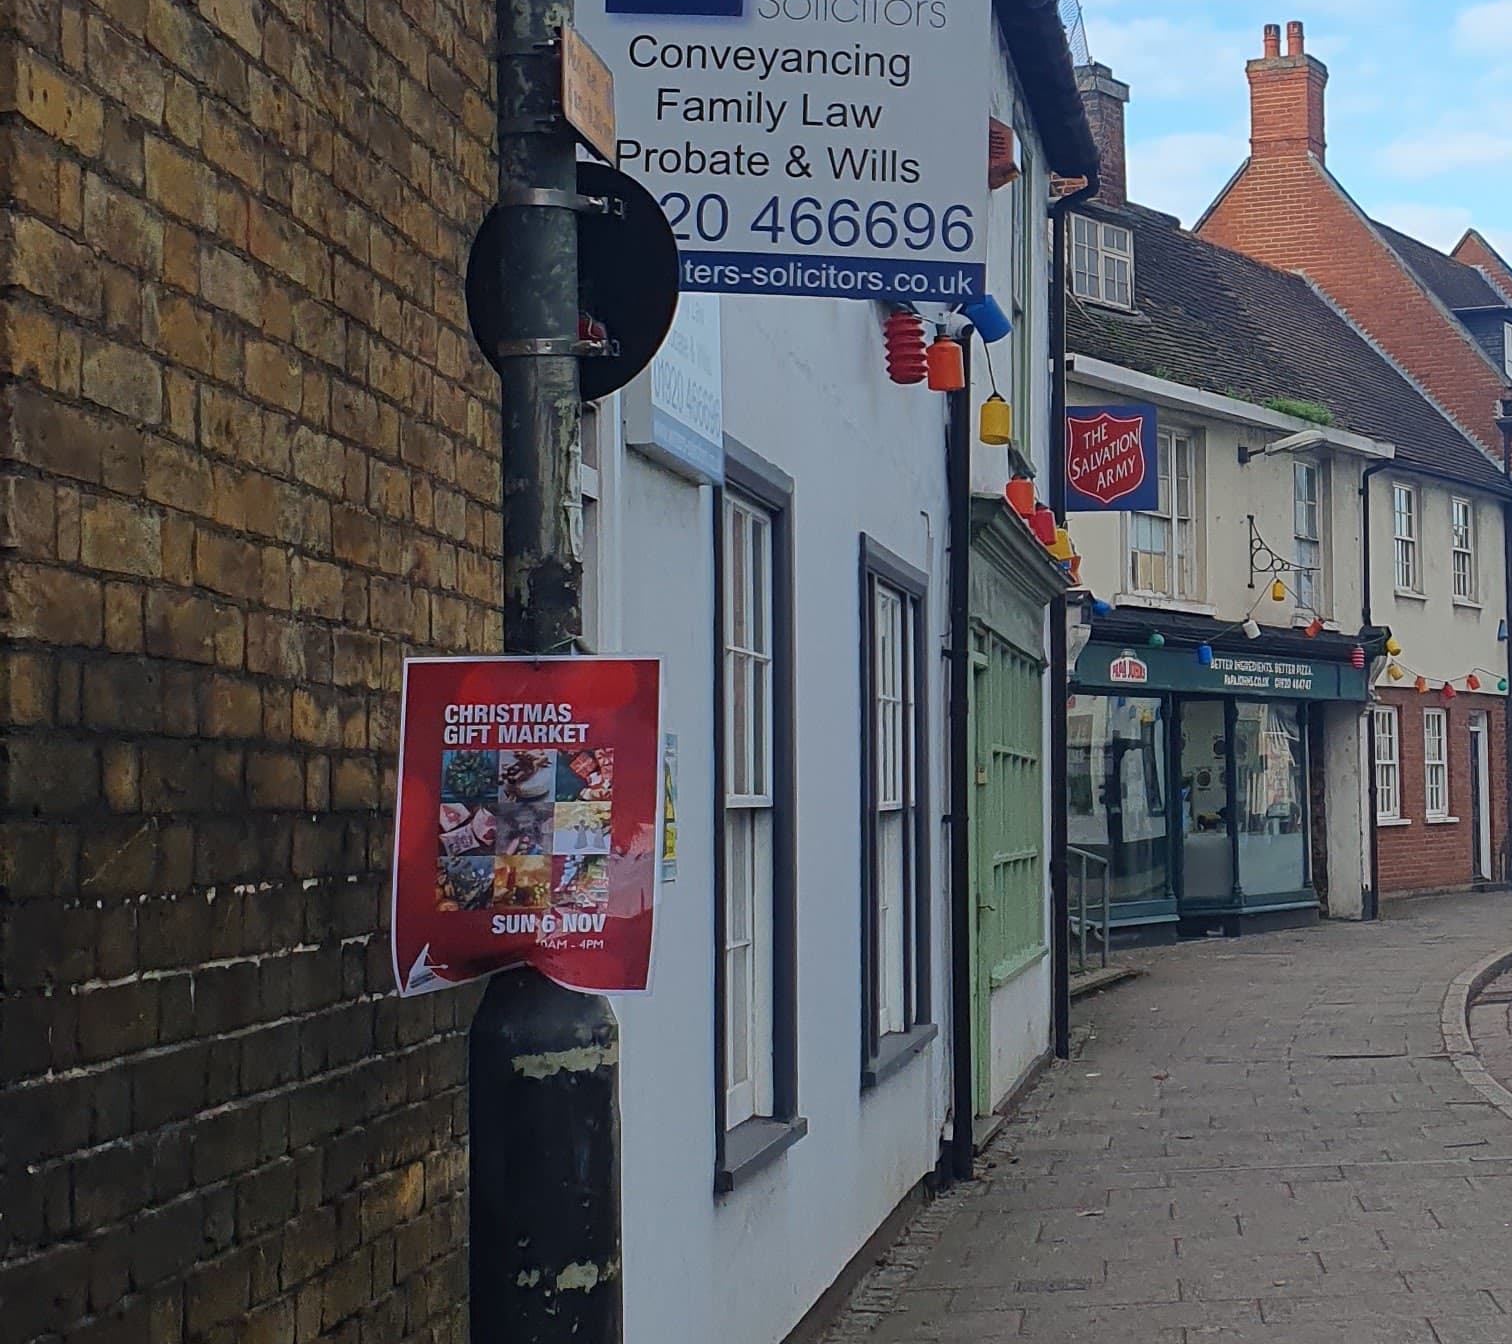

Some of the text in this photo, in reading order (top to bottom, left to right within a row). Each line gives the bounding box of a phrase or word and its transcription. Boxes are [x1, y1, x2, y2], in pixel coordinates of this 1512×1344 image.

[629, 34, 911, 88] Conveyancing
[657, 88, 882, 133] Family Law
[616, 139, 920, 184] Probate & Wills
[660, 192, 975, 252] 20 466696
[683, 259, 974, 297] ters-solicitors.co.uk
[1072, 428, 1139, 480] SALVATION
[1083, 423, 1108, 449] THE
[1096, 455, 1136, 492] ARMY
[445, 703, 573, 724] CHRISTMAS
[444, 723, 590, 744] GIFT MARKET
[491, 913, 607, 935] SUN 6 NOV
[579, 939, 605, 950] 4PM
